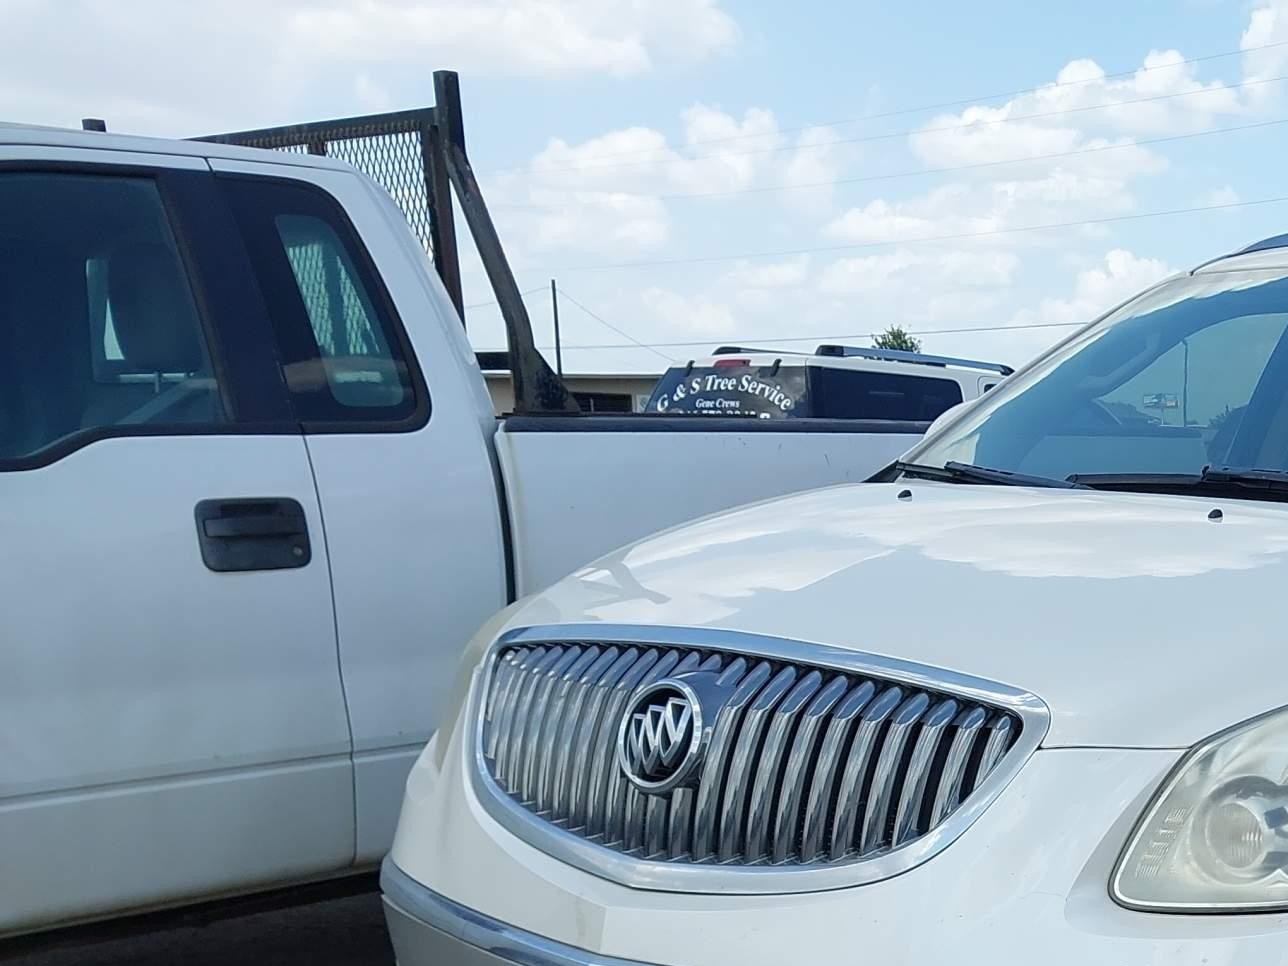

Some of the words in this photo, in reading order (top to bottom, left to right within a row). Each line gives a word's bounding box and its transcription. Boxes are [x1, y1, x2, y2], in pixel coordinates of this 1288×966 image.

[656, 394, 669, 412] G
[673, 384, 687, 402] &
[690, 378, 701, 394] S
[704, 374, 737, 391] Tree
[738, 374, 791, 411] Service
[695, 398, 715, 409] Gene
[715, 398, 740, 409] Crews
